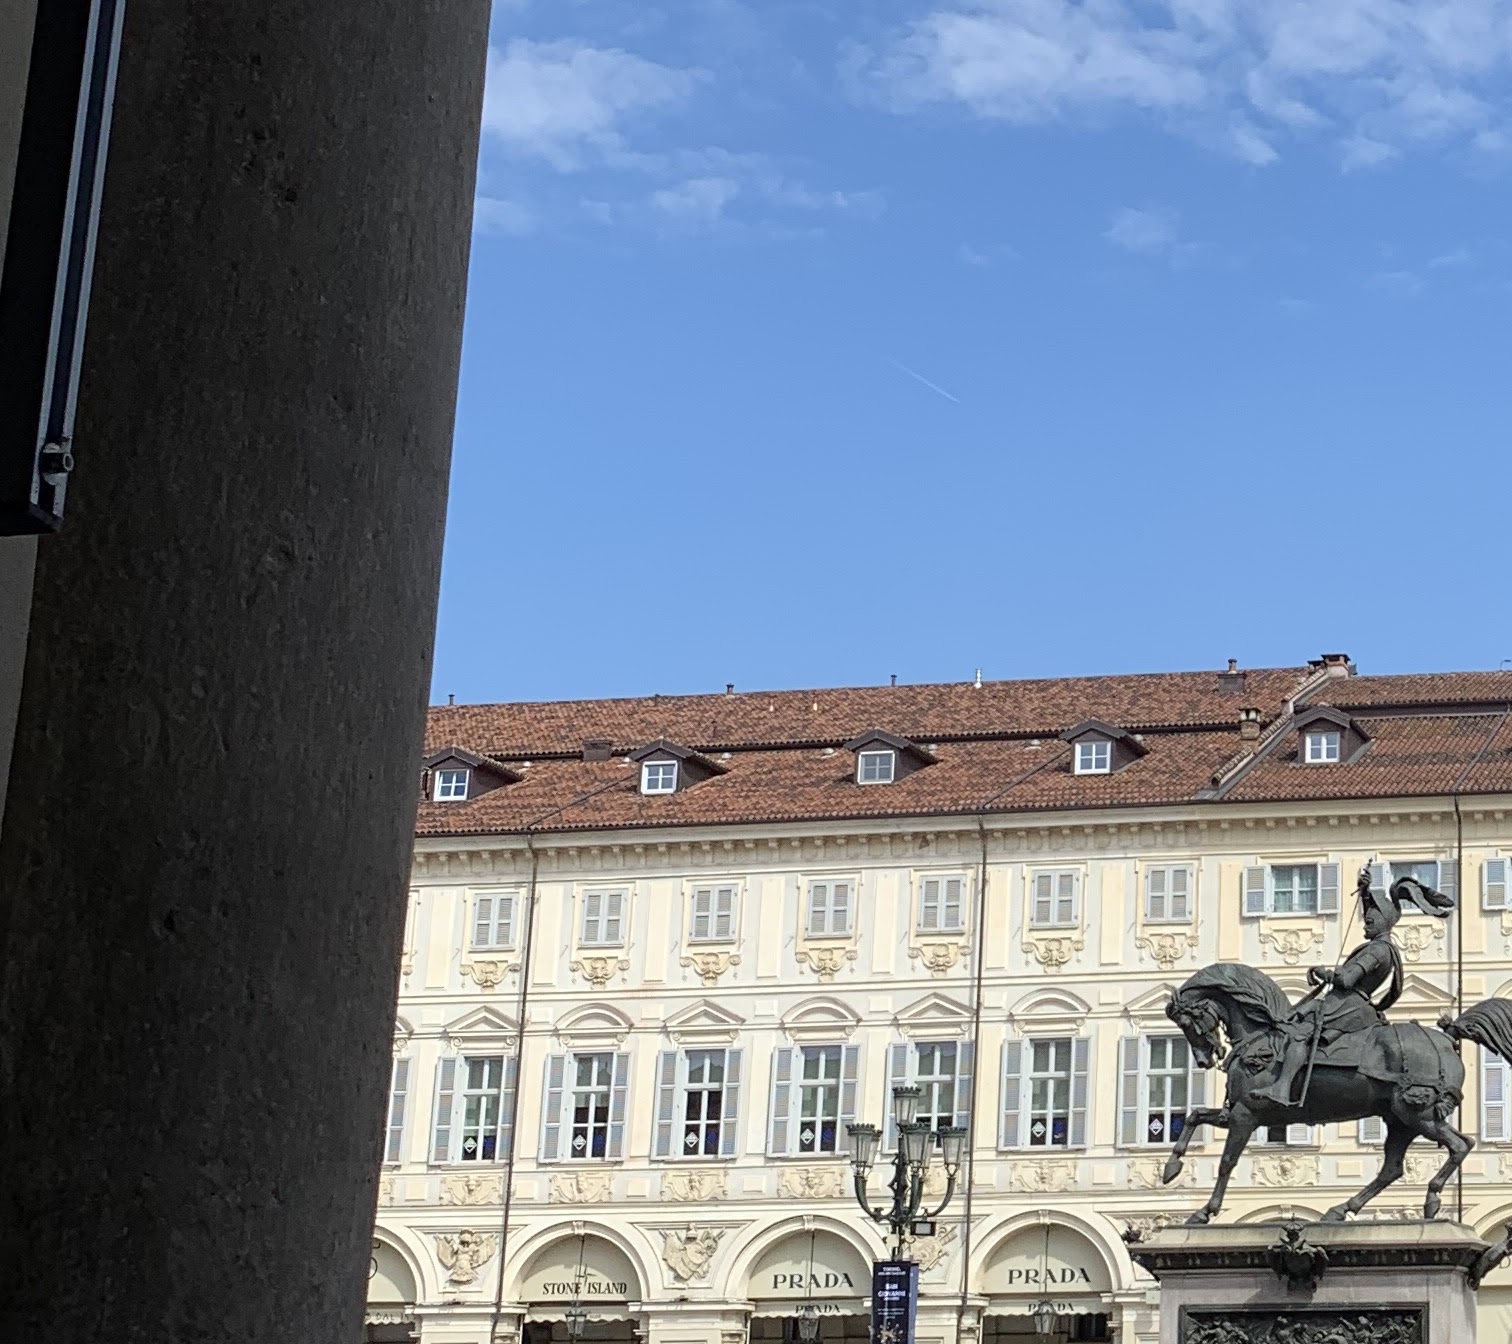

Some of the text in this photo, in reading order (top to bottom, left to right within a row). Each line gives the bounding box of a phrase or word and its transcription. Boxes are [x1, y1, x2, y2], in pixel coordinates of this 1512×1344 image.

[772, 1272, 854, 1289] PRADA
[1008, 1267, 1092, 1285] PRADA
[542, 1282, 627, 1296] STONE ISLAND
